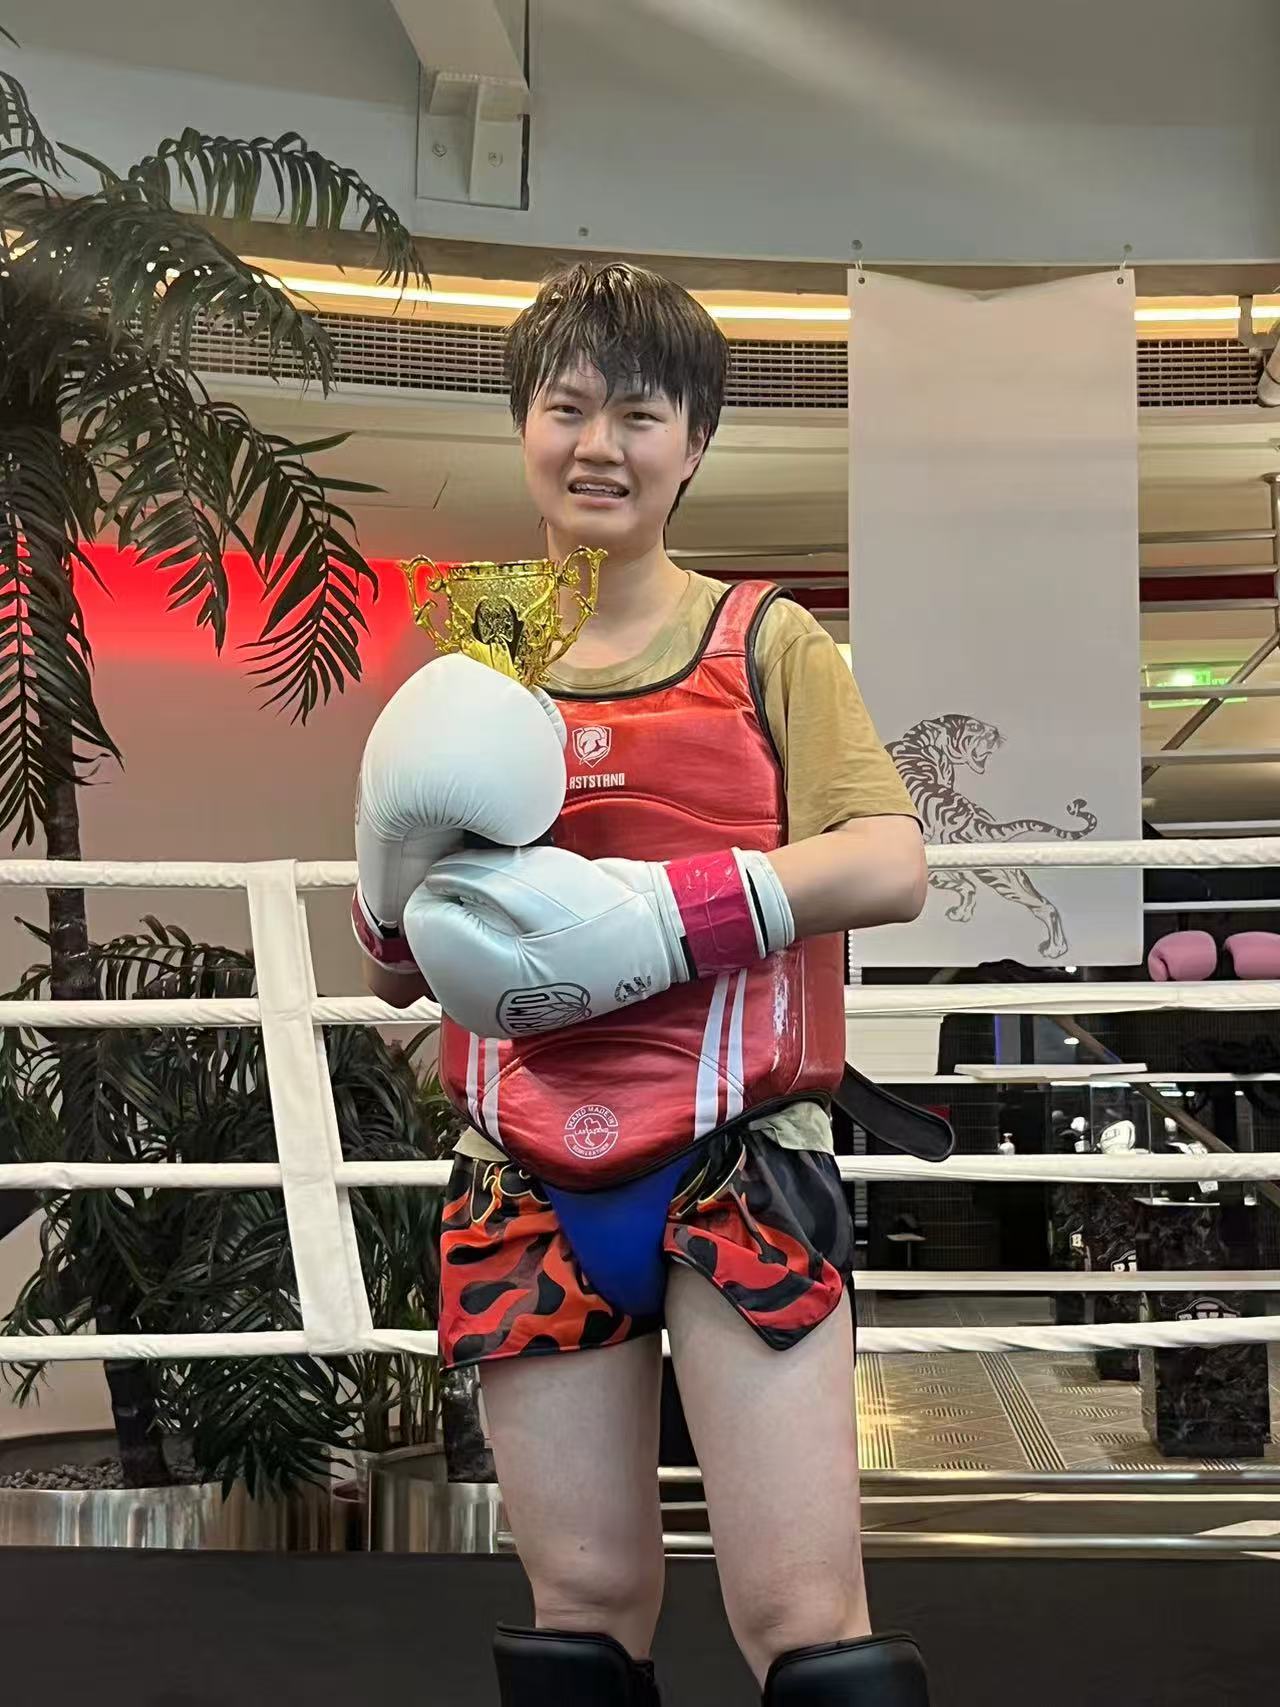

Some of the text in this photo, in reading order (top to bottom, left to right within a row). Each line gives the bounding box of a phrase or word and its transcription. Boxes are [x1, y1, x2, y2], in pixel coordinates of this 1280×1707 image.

[566, 773, 626, 790] ASTSTAND
[568, 1108, 587, 1127] HAND
[588, 1106, 609, 1118] MADE
